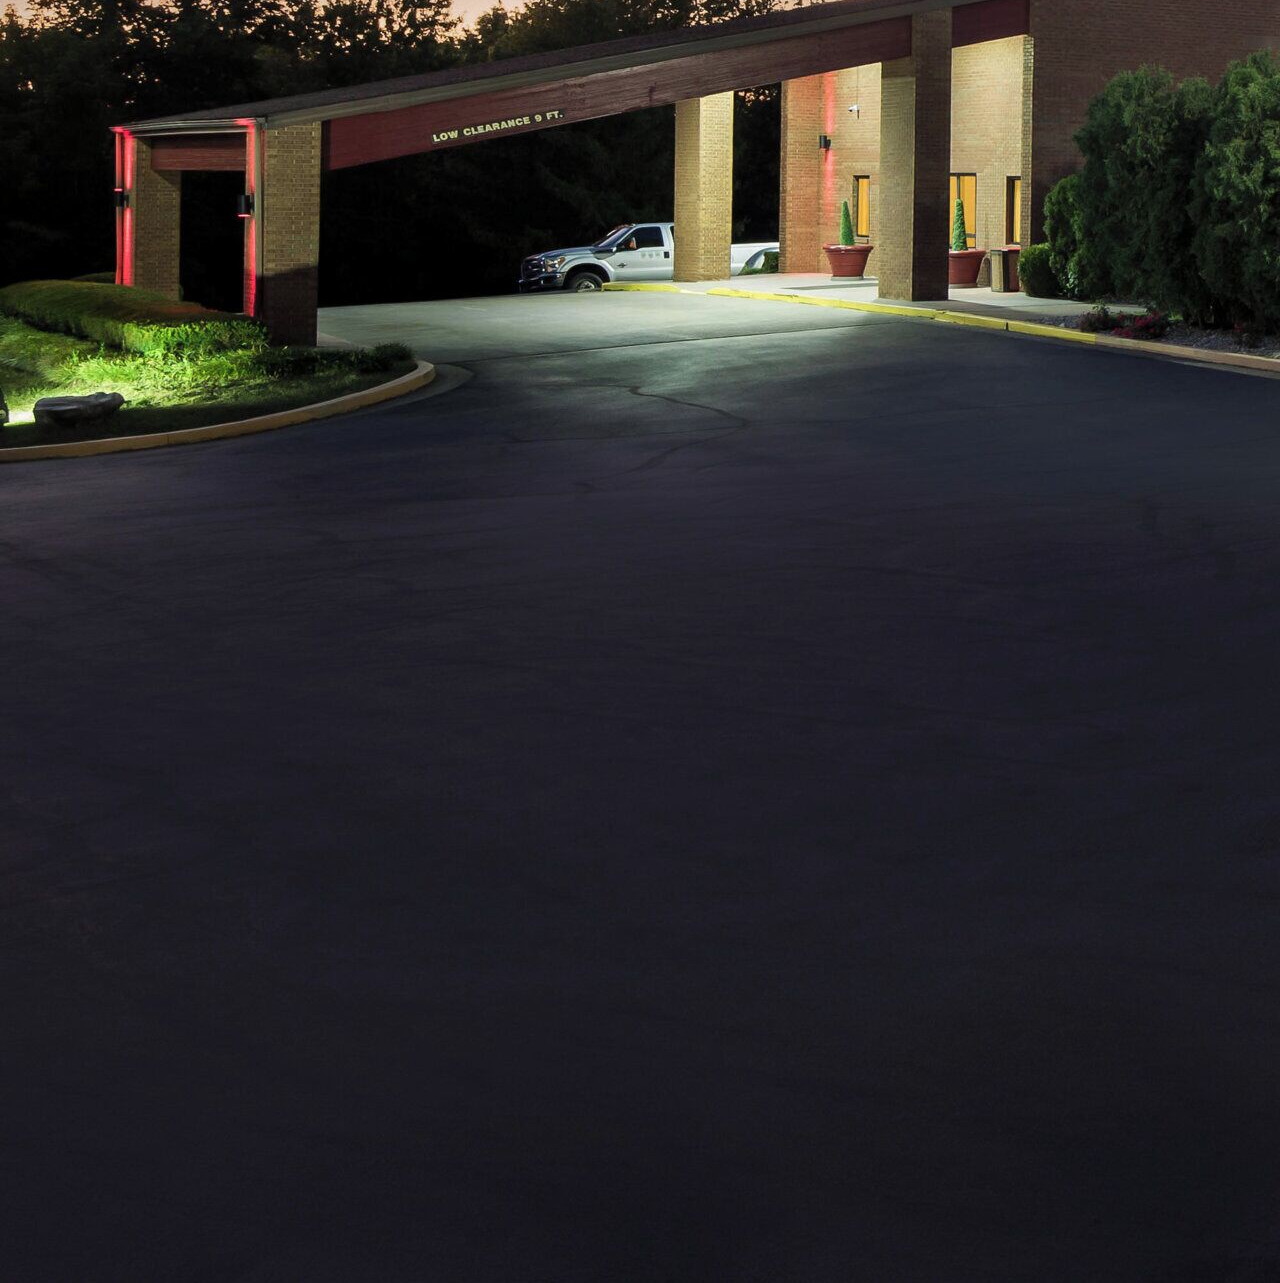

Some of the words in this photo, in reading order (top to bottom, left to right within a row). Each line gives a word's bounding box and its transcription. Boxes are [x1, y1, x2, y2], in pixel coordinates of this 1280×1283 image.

[432, 130, 459, 142] LOW
[463, 117, 531, 136] CLEARANCE
[534, 114, 542, 122] 9
[546, 111, 563, 120] FT.
